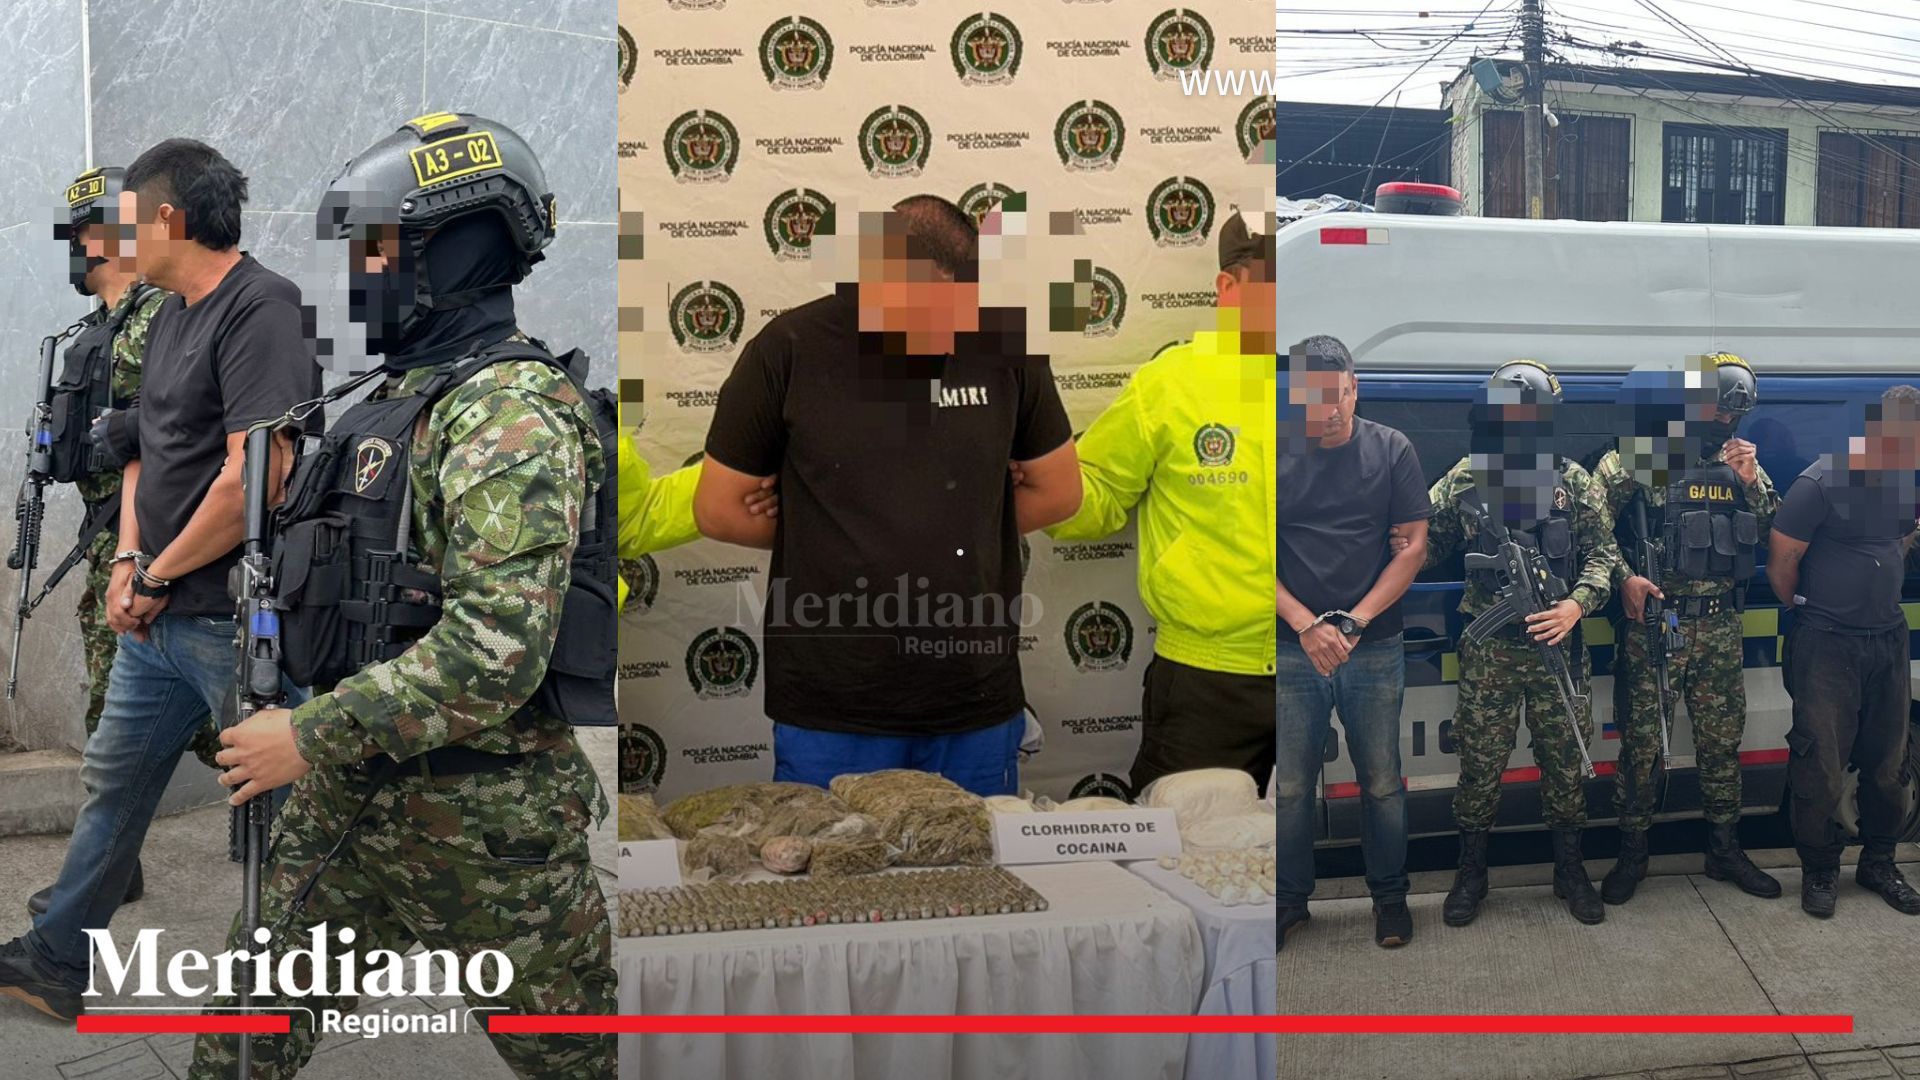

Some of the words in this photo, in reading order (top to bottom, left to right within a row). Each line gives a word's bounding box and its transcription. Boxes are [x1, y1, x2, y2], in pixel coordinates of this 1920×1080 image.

[1047, 39, 1083, 50] POLICÍA
[1083, 40, 1131, 49] NACIONAL
[1229, 35, 1264, 46] POLICÍA
[654, 47, 692, 58] POLICÍA
[694, 48, 744, 57] NACIONAL
[850, 43, 886, 54] POLICÍA
[888, 44, 936, 53] NACIONAL
[1057, 49, 1070, 57] DE
[1071, 48, 1120, 57] COLOMBIA
[666, 57, 679, 66] DE
[681, 56, 733, 65] COLOMBIA
[861, 53, 873, 62] DE
[875, 52, 925, 61] COLOMBIA
[947, 132, 983, 142] POLICÍA
[1140, 126, 1176, 137] POLICÍA
[1177, 127, 1222, 136] NACIONAL
[756, 137, 795, 147] POLICÍA
[797, 137, 844, 146] NACIONAL
[958, 141, 971, 150] DE
[973, 140, 1021, 149] COLOMBIA
[1150, 136, 1163, 144] DE
[1165, 135, 1212, 143] COLOMBIA
[767, 147, 780, 155] DE
[782, 146, 833, 155] COLOMBIA
[1087, 207, 1133, 216] NACIONAL
[1080, 216, 1122, 224] OLOMBIA
[659, 221, 698, 232] POLICÍA
[699, 221, 749, 230] NACIONAL
[671, 229, 685, 238] DE
[687, 228, 738, 238] COLOMBIA
[1142, 292, 1176, 302] POLICÍA
[1177, 291, 1218, 300] NACIONA
[1152, 301, 1164, 309] DE
[1166, 300, 1212, 308] COLOMBIA
[1062, 382, 1074, 390] DE
[1075, 380, 1123, 390] COLOMBIA
[666, 390, 703, 400] POLICÍA
[1188, 471, 1248, 485] 004690
[1689, 485, 1733, 500] GAULA
[1053, 543, 1087, 554] POLICÍA
[1088, 542, 1135, 551] NACIONAL
[1063, 553, 1076, 561] DE
[1077, 551, 1125, 560] COLOMBIA
[674, 568, 711, 578] POLICÍA
[713, 566, 761, 575] NACIONAL
[686, 578, 699, 586] DE
[622, 661, 672, 671] NACIONAL
[618, 669, 661, 680] OLOMBIA
[1062, 717, 1097, 728] POLICÍA
[1098, 715, 1143, 724] NACIONAL
[1072, 726, 1085, 734] DE
[1086, 723, 1134, 733] COLOMBIA
[683, 746, 719, 757] POLICÍA
[721, 743, 769, 753] NACIONAL
[694, 755, 707, 764] DE
[709, 752, 760, 763] COLOMBIA
[1021, 823, 1131, 836] CLORHIDRATO
[1136, 822, 1156, 833] DE
[1056, 842, 1127, 855] COCAINA
